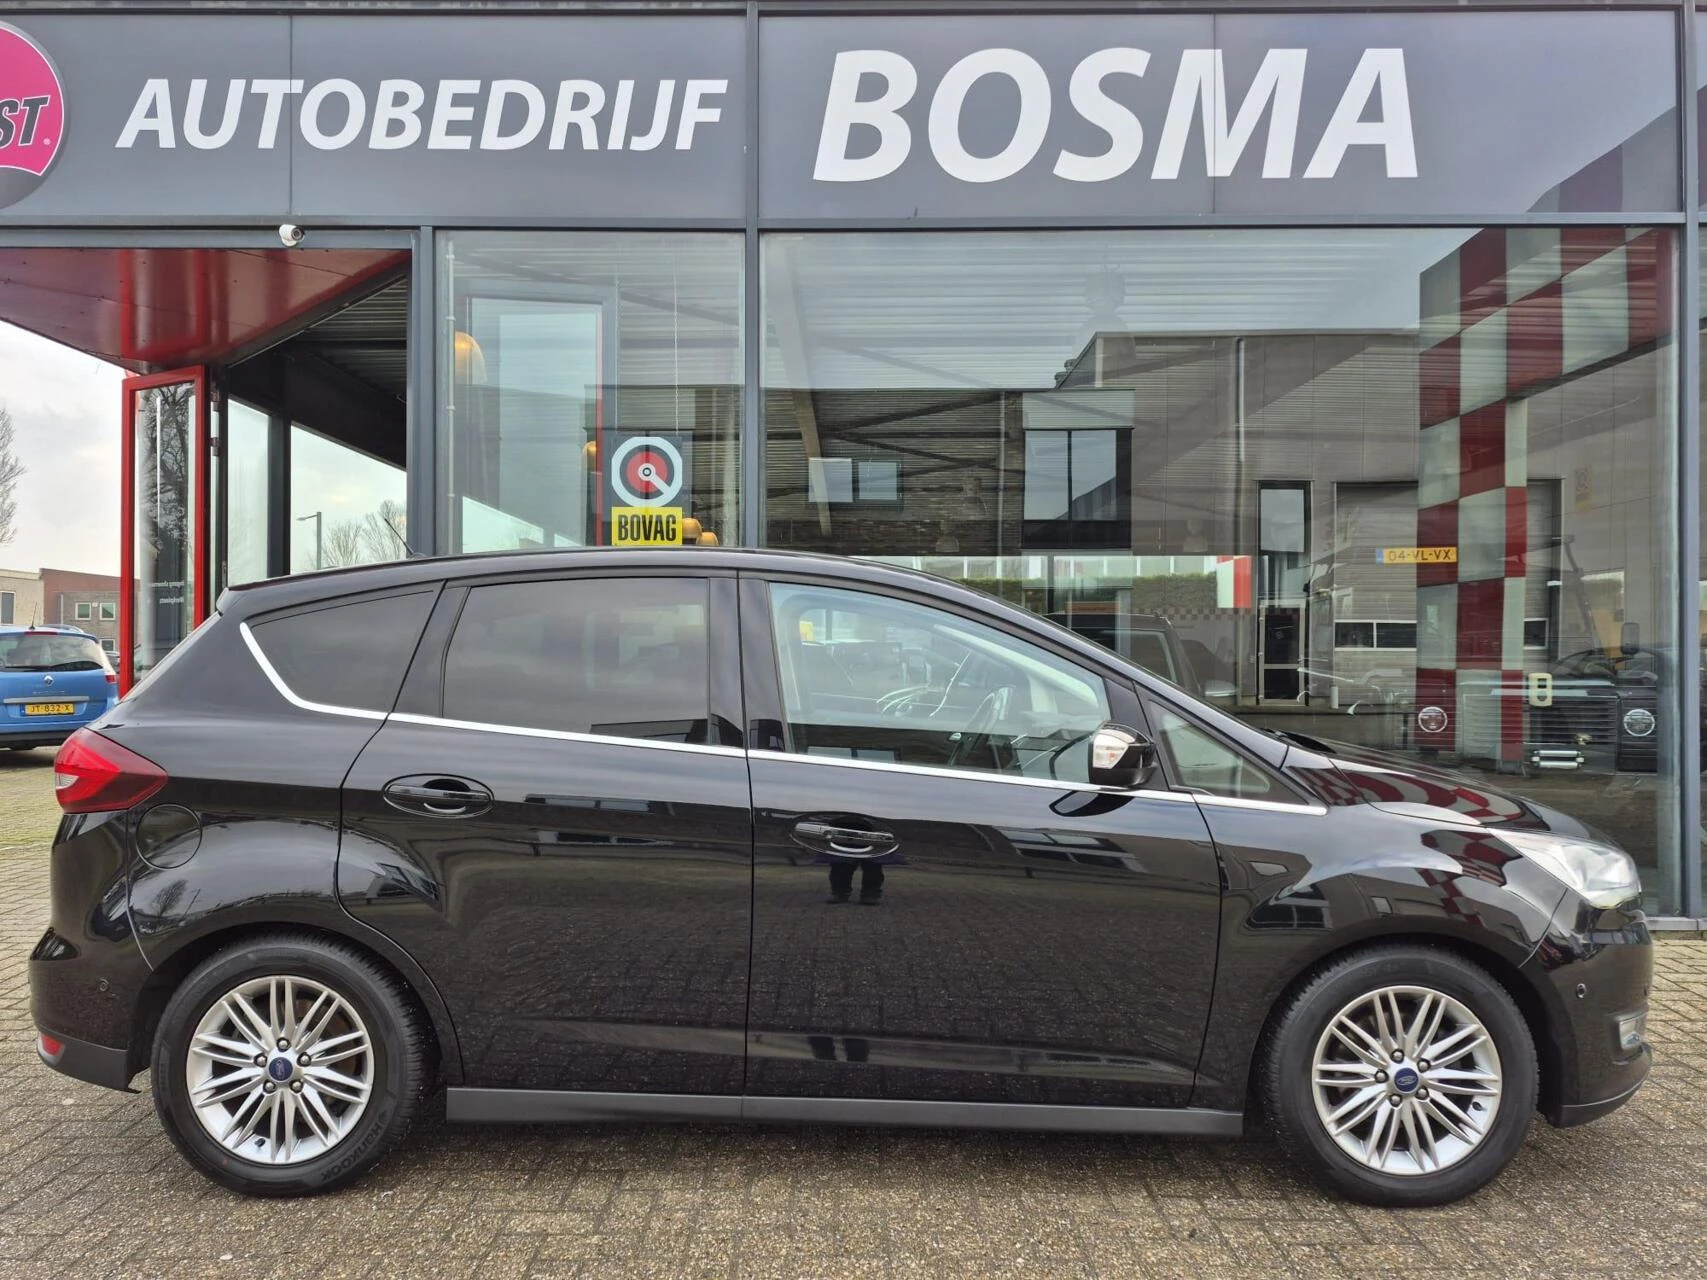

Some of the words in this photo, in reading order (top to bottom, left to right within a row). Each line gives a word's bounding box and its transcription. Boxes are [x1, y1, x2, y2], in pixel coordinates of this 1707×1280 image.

[115, 78, 728, 151] AUTOBEDRIJF
[812, 47, 1418, 182] BOSMA
[617, 514, 677, 541] BOVAG
[1388, 549, 1451, 562] 04-VL-VX
[30, 704, 70, 713] JT-832-X
